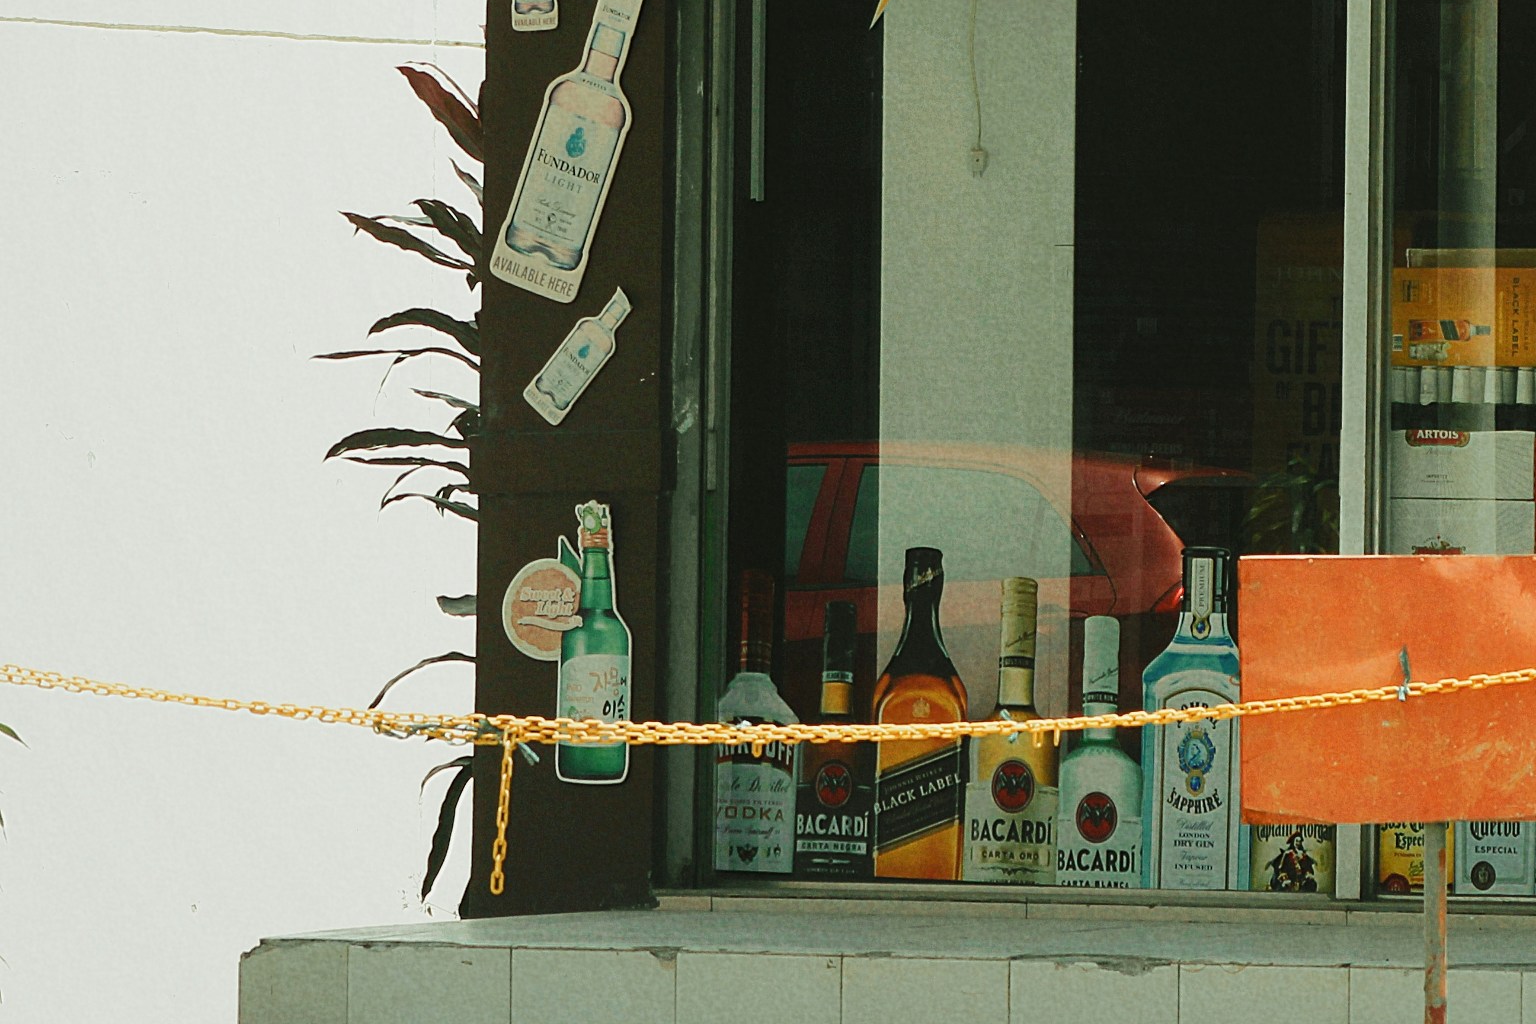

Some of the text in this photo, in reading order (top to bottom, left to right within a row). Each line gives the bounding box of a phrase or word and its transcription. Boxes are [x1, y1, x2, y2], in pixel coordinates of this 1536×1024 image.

[537, 147, 601, 185] FUNDADOR
[544, 171, 583, 194] LIGHT
[493, 255, 575, 297] AVAILABLE HERE
[1511, 277, 1520, 358] BLACK LABEL
[1416, 429, 1459, 440] ARTOIS
[562, 587, 575, 602] &
[873, 790, 916, 815] BLACK
[919, 773, 962, 800] LABEL
[1166, 786, 1223, 816] SAPPHIRE
[796, 810, 869, 838] BACARDÍ
[970, 815, 1052, 845] BACARDÍ
[1469, 821, 1521, 842] Cuervo
[800, 841, 862, 852] CARTA NEGRA
[1173, 839, 1216, 849] DRY GIN
[1394, 832, 1425, 851] Especi
[1474, 845, 1519, 855] ESPECIAL
[981, 850, 1040, 862] CARTA ORO
[1057, 844, 1136, 873] BACARDÍ
[1174, 863, 1214, 872] INFUSED
